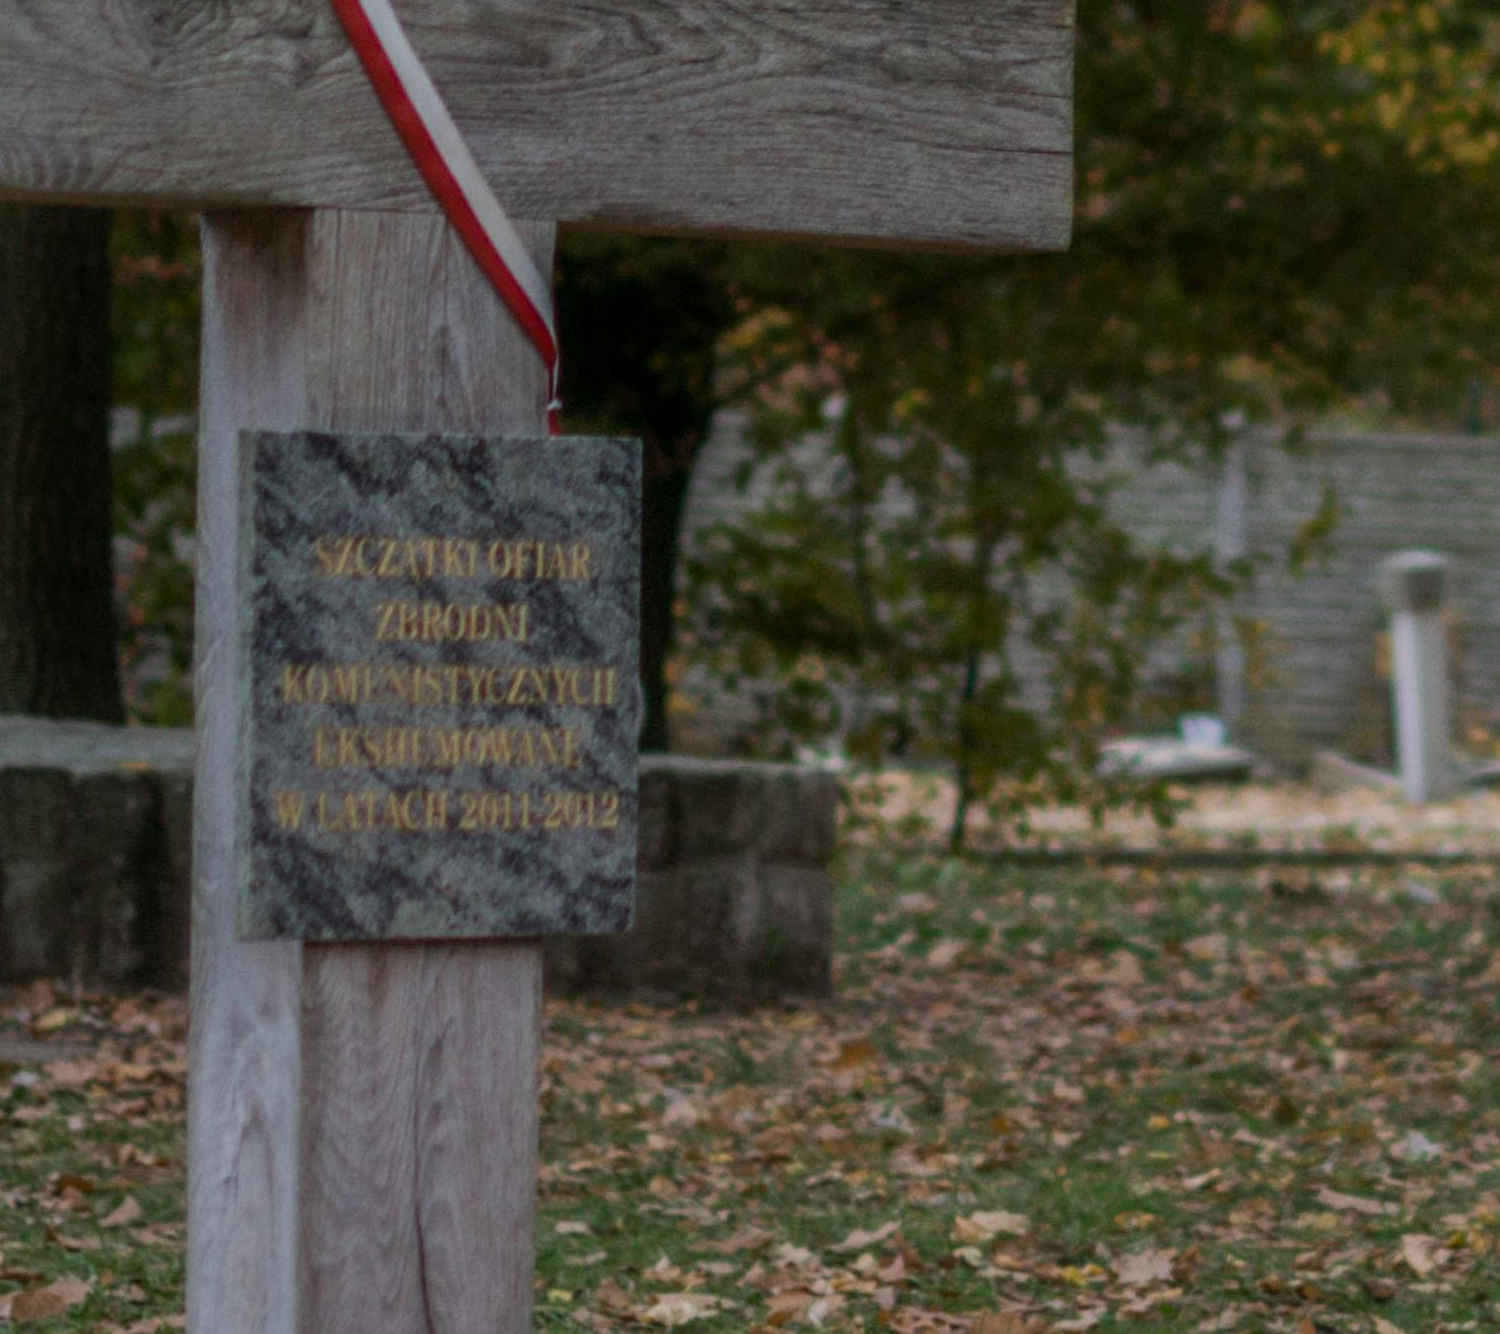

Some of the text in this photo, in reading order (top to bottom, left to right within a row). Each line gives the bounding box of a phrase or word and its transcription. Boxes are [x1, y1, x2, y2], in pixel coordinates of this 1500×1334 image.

[309, 538, 592, 585] SZCZĄTKI OFIAR
[374, 600, 530, 643] ZBRODNI
[281, 665, 617, 706] KOMUNISTYCZNYCH
[311, 726, 585, 766] EKSHUMOWANE
[272, 789, 619, 830] W LATACH 2011-2012
